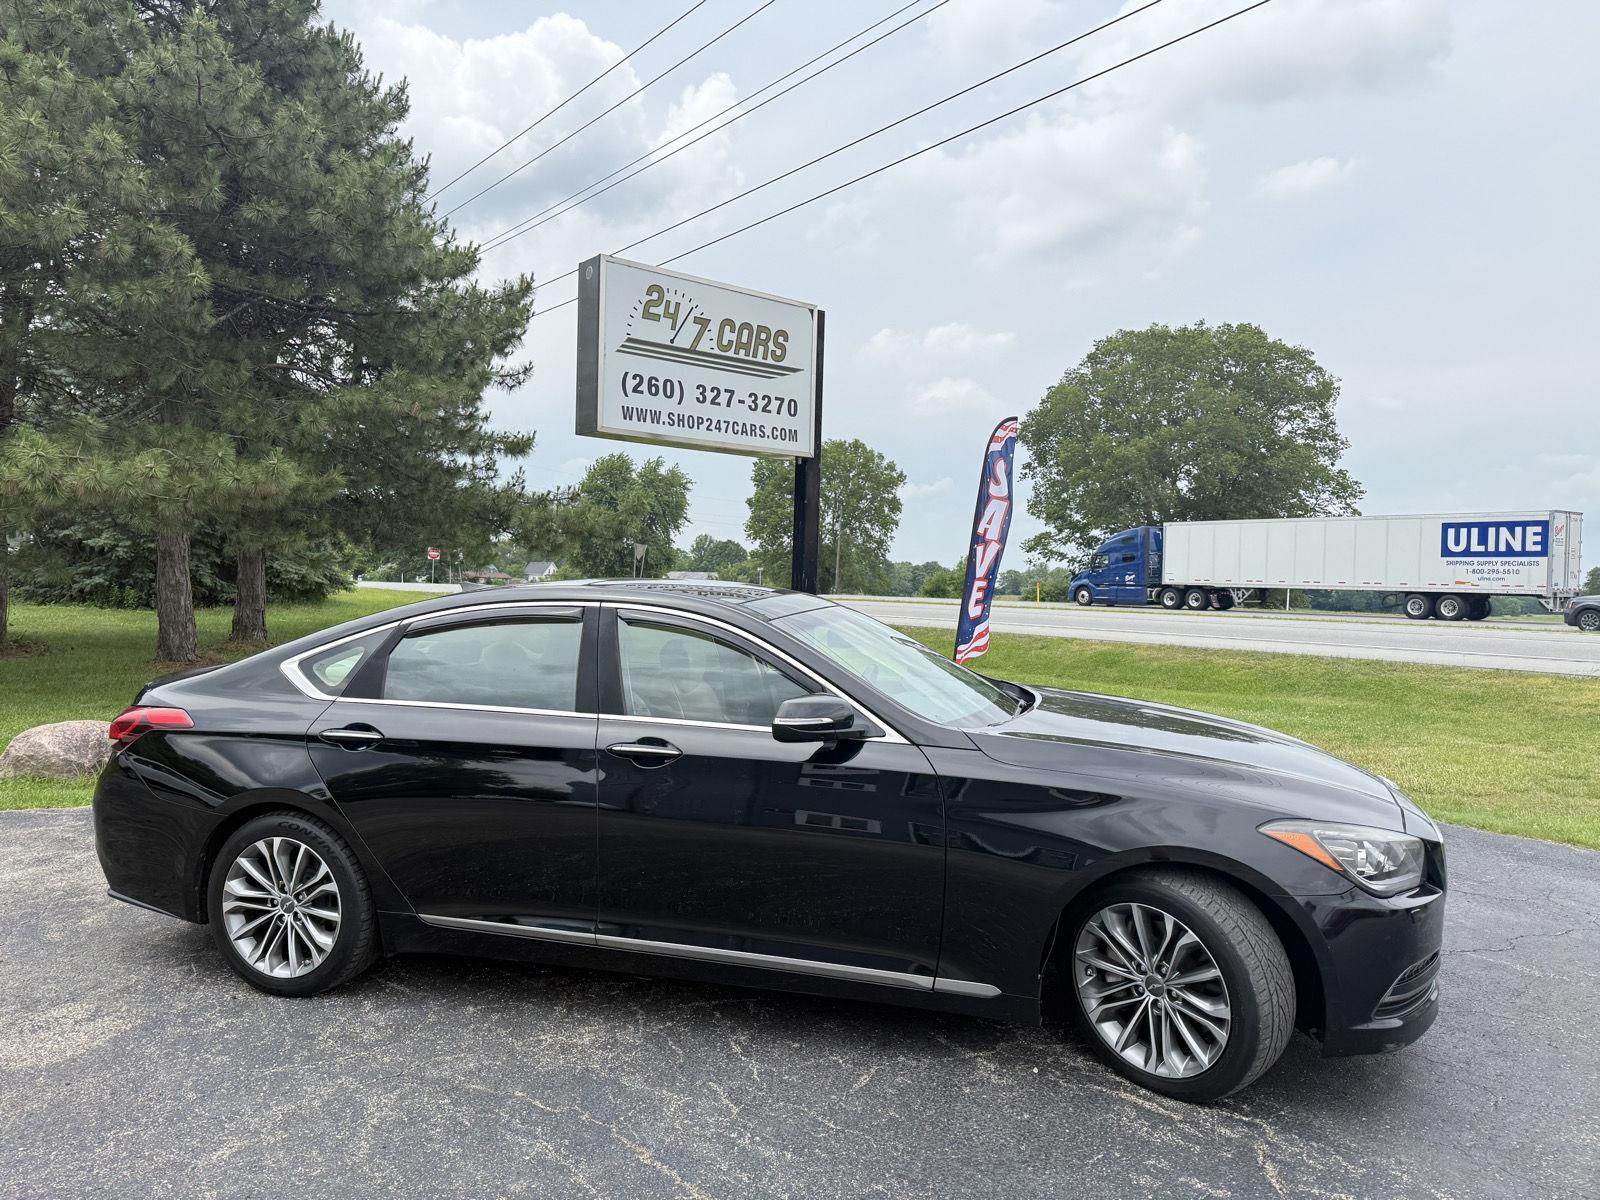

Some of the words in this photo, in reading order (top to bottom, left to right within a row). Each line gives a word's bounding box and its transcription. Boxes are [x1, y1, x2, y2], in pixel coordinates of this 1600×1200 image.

[641, 284, 711, 351] 24/7
[716, 318, 789, 362] CARS
[621, 371, 684, 405] (260)
[695, 384, 799, 418] 327-3270
[621, 405, 799, 443] WWW.SHOP247CARS.COM
[968, 457, 1010, 620] SAVE
[1447, 526, 1542, 553] ULINE
